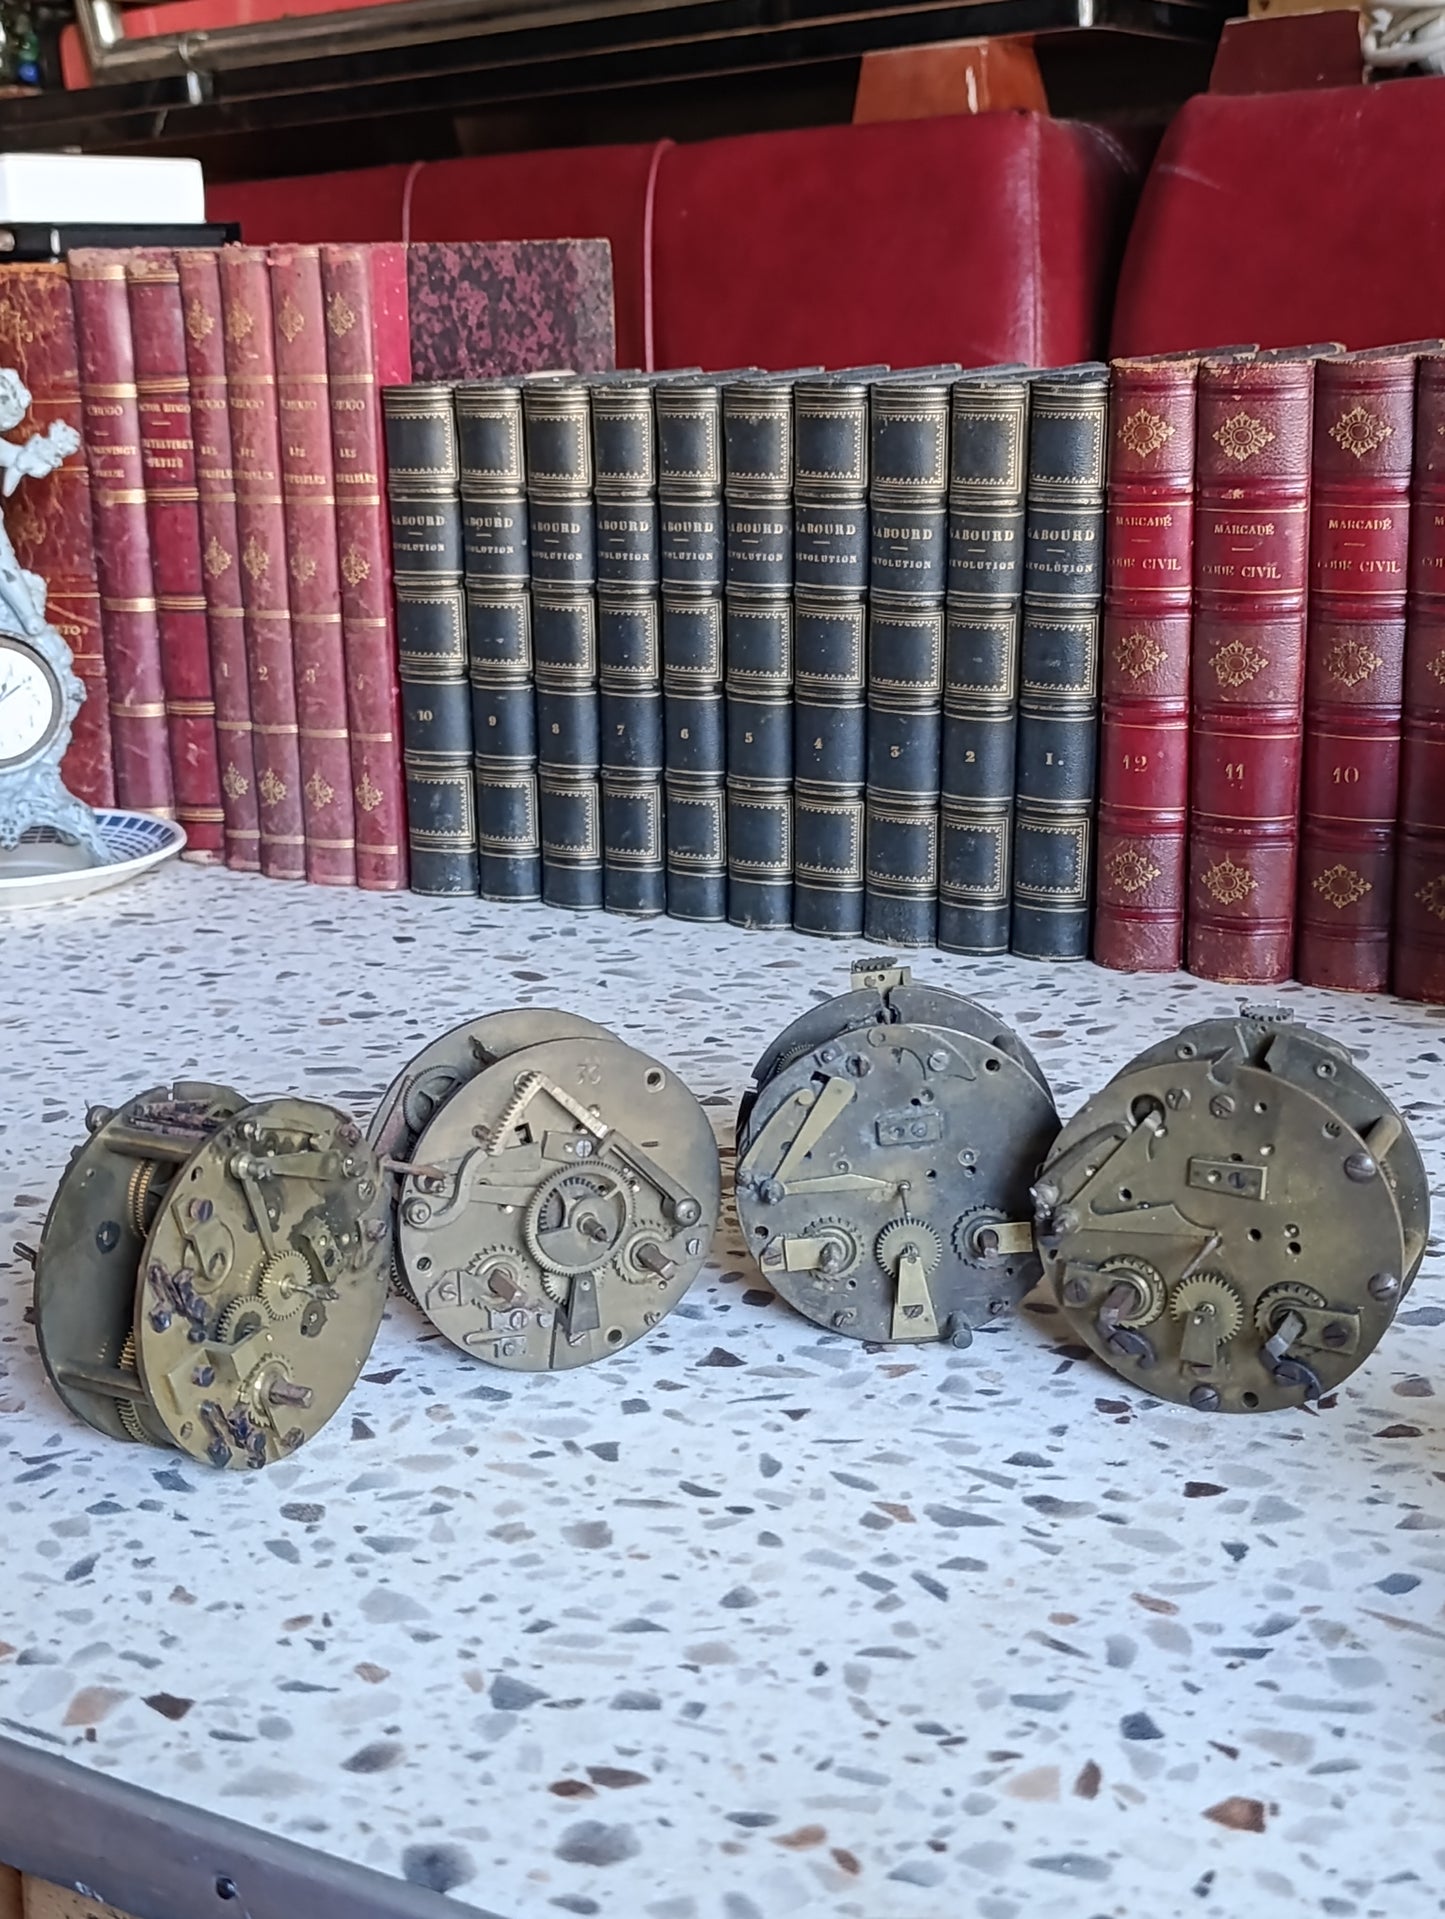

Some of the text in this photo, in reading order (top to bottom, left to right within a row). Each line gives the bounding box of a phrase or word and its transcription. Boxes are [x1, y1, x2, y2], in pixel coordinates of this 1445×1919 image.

[392, 515, 445, 526] ABOURD
[464, 517, 514, 528] ABOURD
[599, 520, 649, 532] ABOURD
[1116, 514, 1173, 528] MARCADÉ
[1329, 517, 1393, 530] MARCADÉ
[662, 521, 714, 533] ABOURD
[728, 522, 784, 535] ABOURD
[1214, 523, 1275, 536] MARCADÉ
[1142, 558, 1182, 571] CIVIL
[1360, 561, 1401, 573] CIVIL
[1241, 566, 1282, 579] CIVIL
[257, 665, 269, 681] 2
[306, 668, 316, 684] 3
[418, 710, 433, 721] 10
[489, 715, 497, 726] 9
[552, 723, 560, 734] 8
[617, 725, 625, 735] 7
[680, 728, 689, 739] 6
[745, 732, 753, 743] 5
[814, 738, 823, 749] 4
[890, 746, 900, 758] 3
[965, 751, 976, 763] 2
[1122, 754, 1147, 772] 12
[1226, 763, 1244, 779] 11
[1333, 767, 1360, 784] 10
